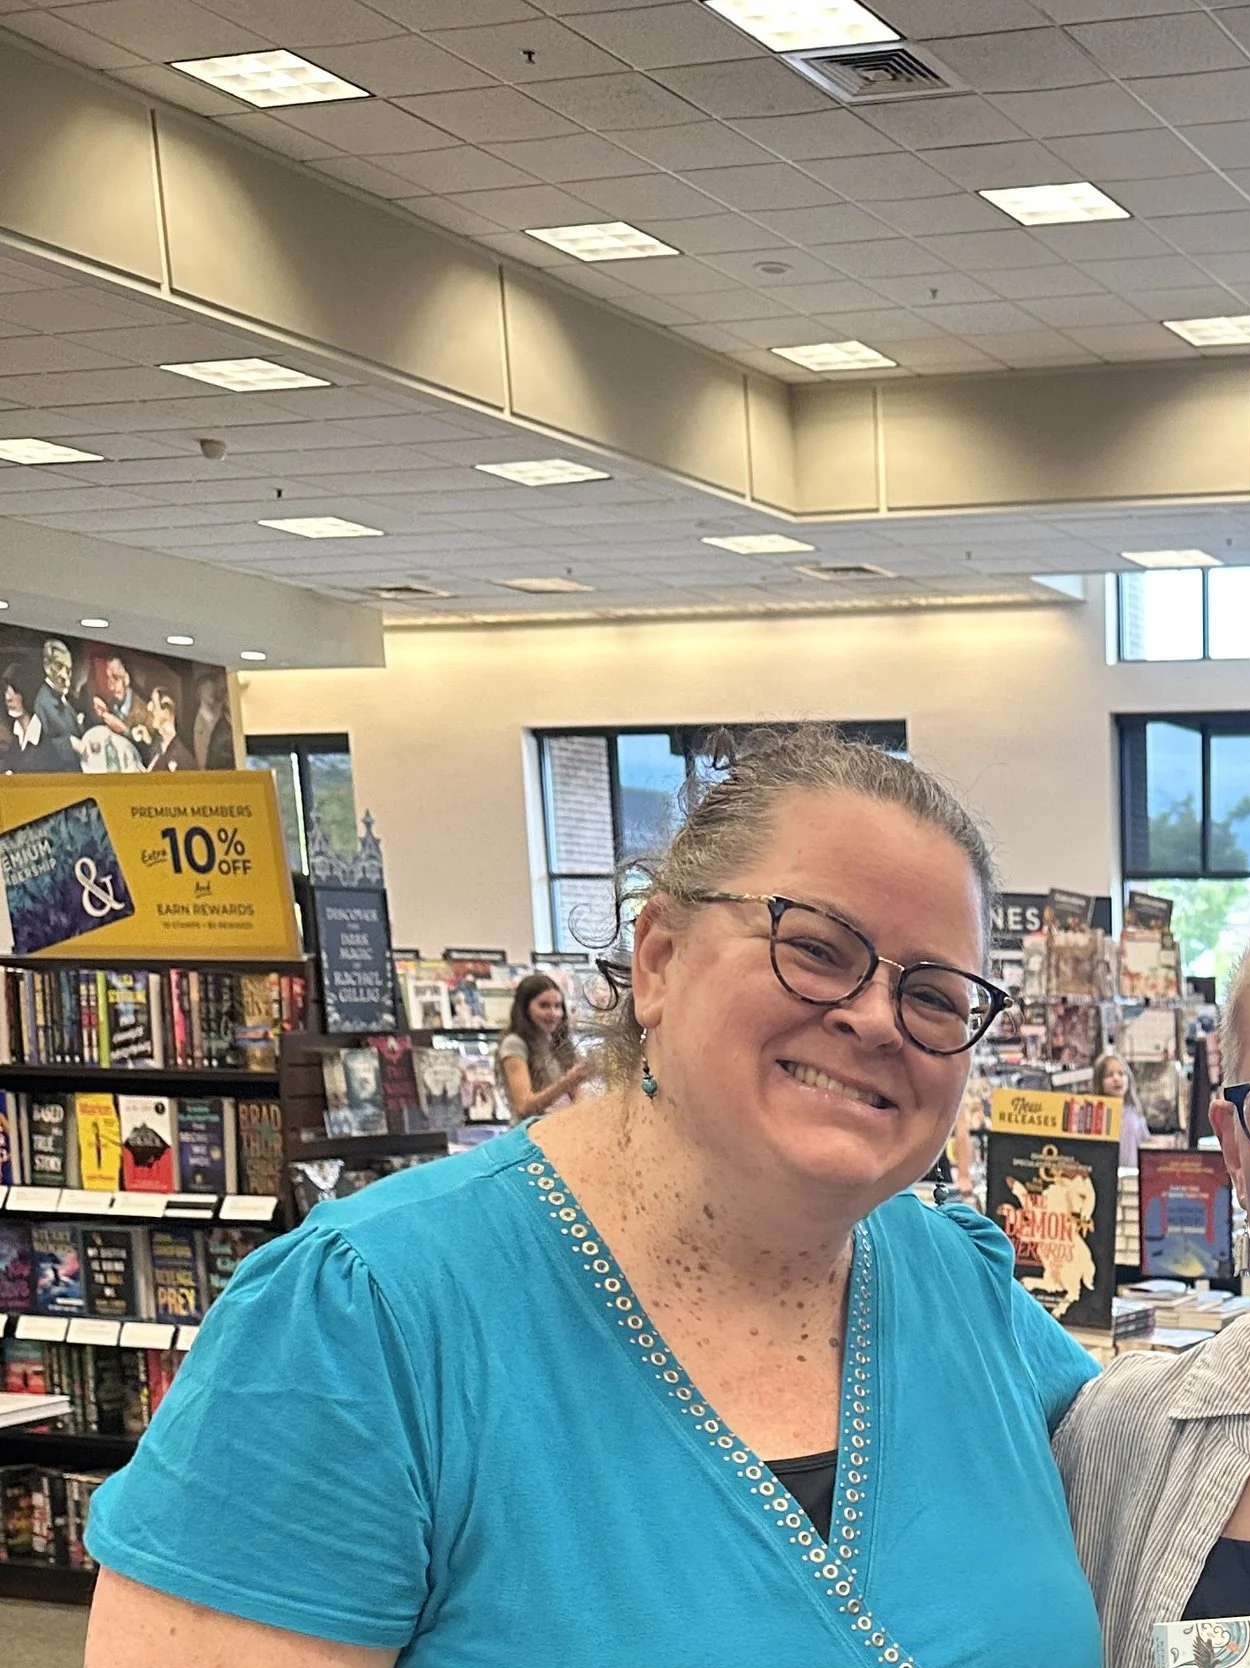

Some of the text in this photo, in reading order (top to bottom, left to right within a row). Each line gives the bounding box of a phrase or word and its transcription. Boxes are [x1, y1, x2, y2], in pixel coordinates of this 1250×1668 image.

[131, 804, 253, 818] PREMIUM MEMBERS
[217, 859, 252, 876] OFF
[156, 902, 255, 917] EARN REWARDS
[238, 1104, 282, 1131] BRAD
[998, 1112, 1057, 1128] RELEASES
[157, 1286, 197, 1317] PREY
